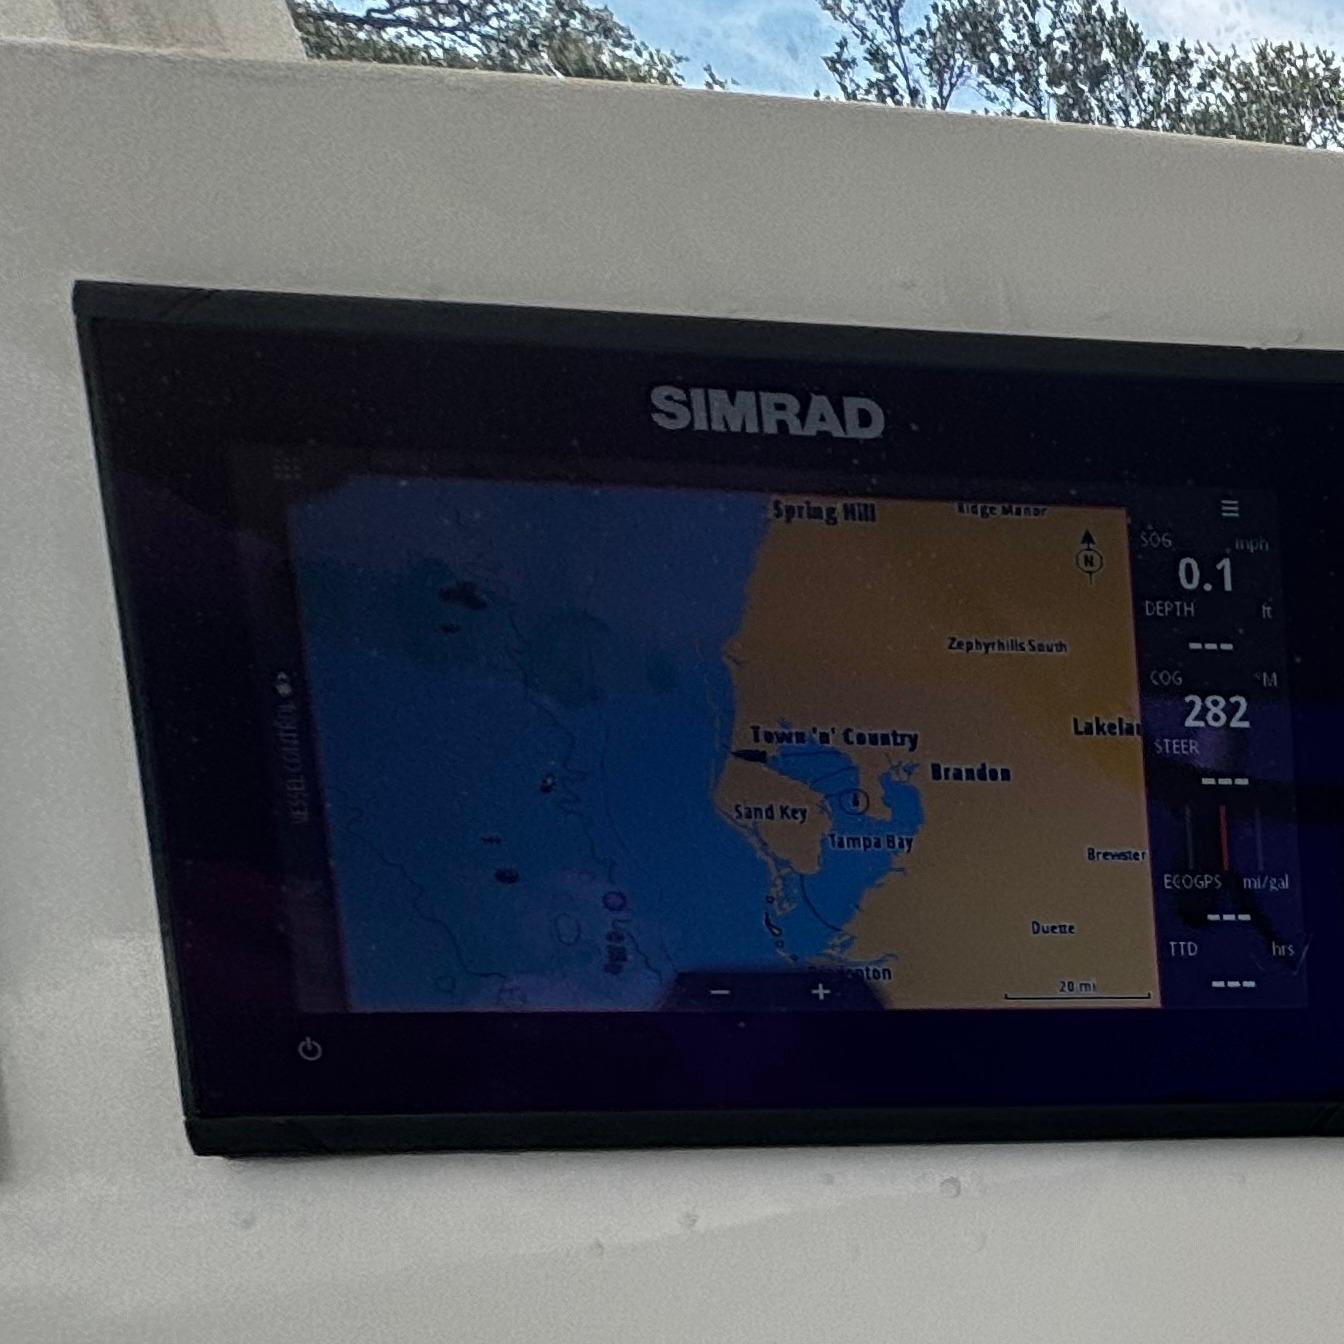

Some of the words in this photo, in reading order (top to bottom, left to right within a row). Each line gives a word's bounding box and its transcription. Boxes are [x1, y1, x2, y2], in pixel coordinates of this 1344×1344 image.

[650, 385, 885, 440] SIMRAD
[773, 500, 837, 525] Spring
[843, 503, 876, 522] Hill
[1140, 532, 1173, 548] SOG
[1178, 557, 1232, 592] 0.1
[1145, 601, 1196, 617] DEPTH
[1262, 603, 1273, 620] ft
[947, 637, 1026, 656] Zephyrhills
[1150, 670, 1183, 686] COG
[1184, 694, 1251, 728] 282
[751, 726, 806, 745] Town
[843, 728, 919, 752] Country
[1154, 738, 1200, 755] STEER
[931, 764, 1011, 782] Brandon
[734, 804, 774, 821] Sand
[779, 805, 808, 824] Key
[829, 833, 881, 852] Tampa
[886, 835, 914, 854] Bay
[1087, 848, 1147, 862] Brewster
[1163, 873, 1223, 891] ECOGPS
[1242, 873, 1290, 892] mi/gal
[1168, 941, 1199, 957] TTD
[1272, 941, 1295, 957] hrs
[1059, 980, 1076, 993] 20
